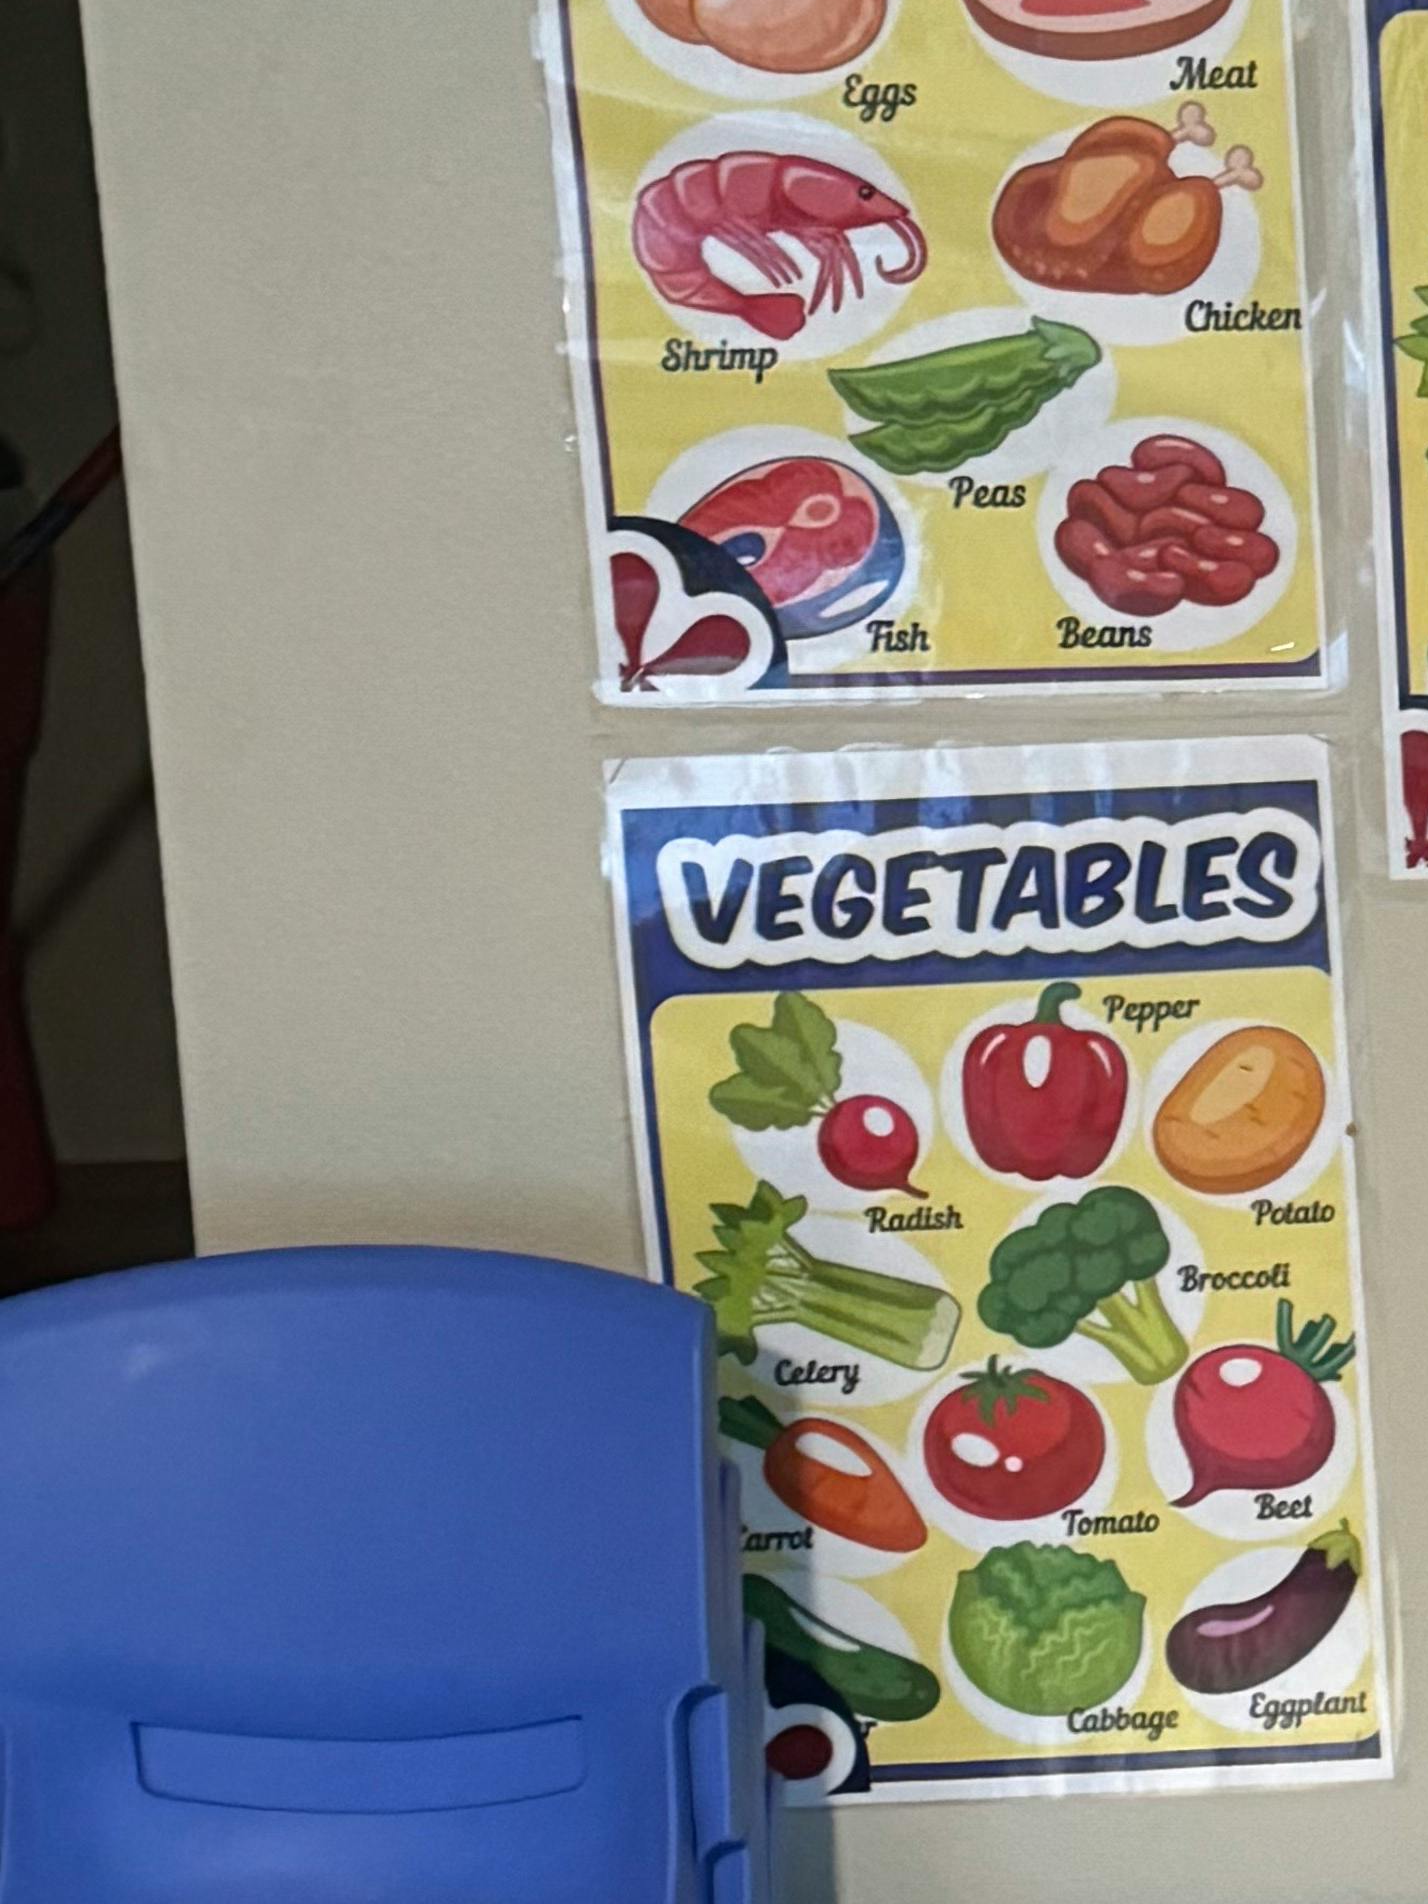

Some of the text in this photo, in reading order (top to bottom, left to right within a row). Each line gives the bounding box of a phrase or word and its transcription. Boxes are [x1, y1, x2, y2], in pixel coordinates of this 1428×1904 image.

[1169, 57, 1258, 92] Meat
[842, 75, 917, 122] Eggs
[1184, 300, 1302, 333] Chicken
[661, 339, 778, 383] Shrimp
[948, 476, 1027, 511] Peas
[867, 621, 930, 654] Fish
[1056, 619, 1153, 650] Beans
[680, 830, 1299, 946] VEGETABLES
[1103, 994, 1200, 1033] Pepper
[864, 1205, 963, 1235] Radish
[1251, 1199, 1335, 1227] Potato
[1178, 1263, 1291, 1292] Broccoli
[774, 1358, 861, 1394] Celery
[1061, 1509, 1160, 1538] Tomato
[1254, 1493, 1312, 1522] Beet
[740, 1524, 814, 1552] arrot
[1067, 1708, 1179, 1743] Cabbage
[1248, 1692, 1368, 1730] Eggplant
